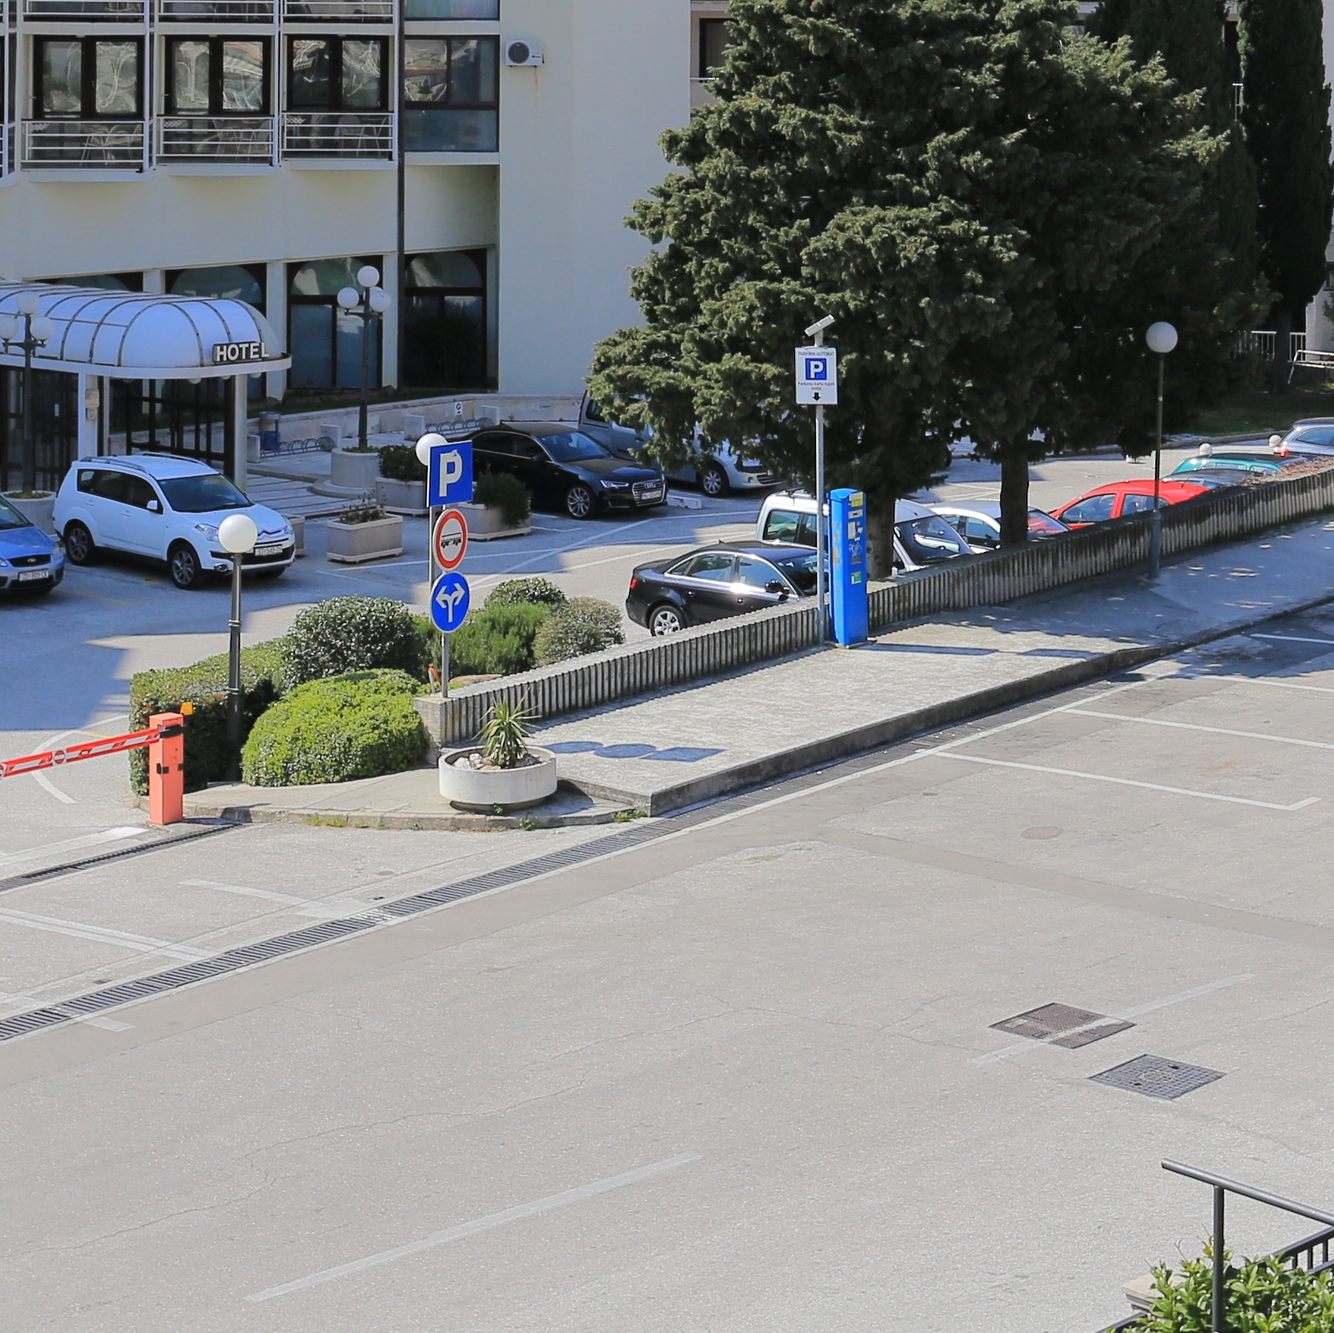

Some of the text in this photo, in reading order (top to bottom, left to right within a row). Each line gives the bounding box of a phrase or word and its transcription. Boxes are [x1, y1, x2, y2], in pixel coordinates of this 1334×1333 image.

[216, 342, 269, 361] HOTEL
[810, 360, 824, 378] P
[439, 452, 463, 497] P
